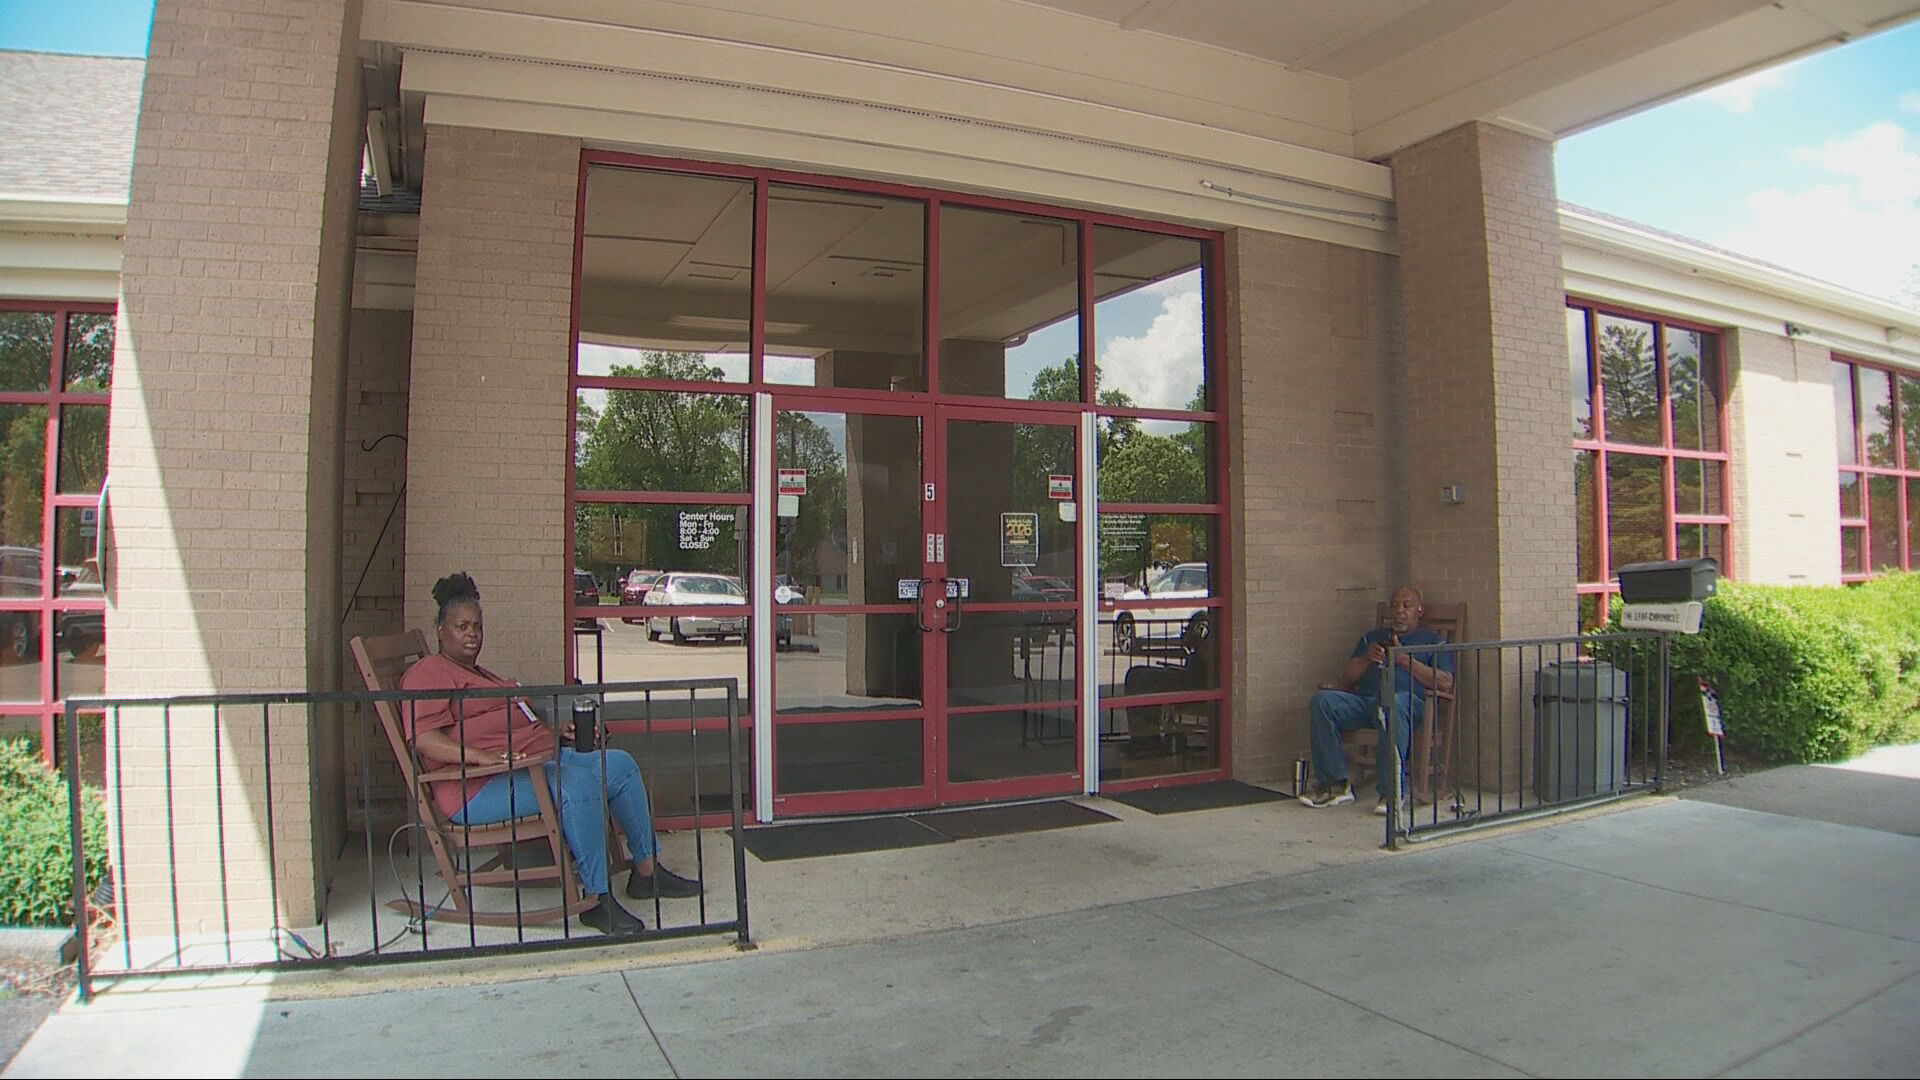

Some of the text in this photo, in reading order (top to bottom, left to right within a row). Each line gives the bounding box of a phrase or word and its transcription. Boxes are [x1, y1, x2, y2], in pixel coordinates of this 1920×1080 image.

[927, 485, 933, 500] 5
[679, 511, 735, 521] Center Hours
[679, 520, 698, 528] Mon
[703, 520, 714, 528] Fri
